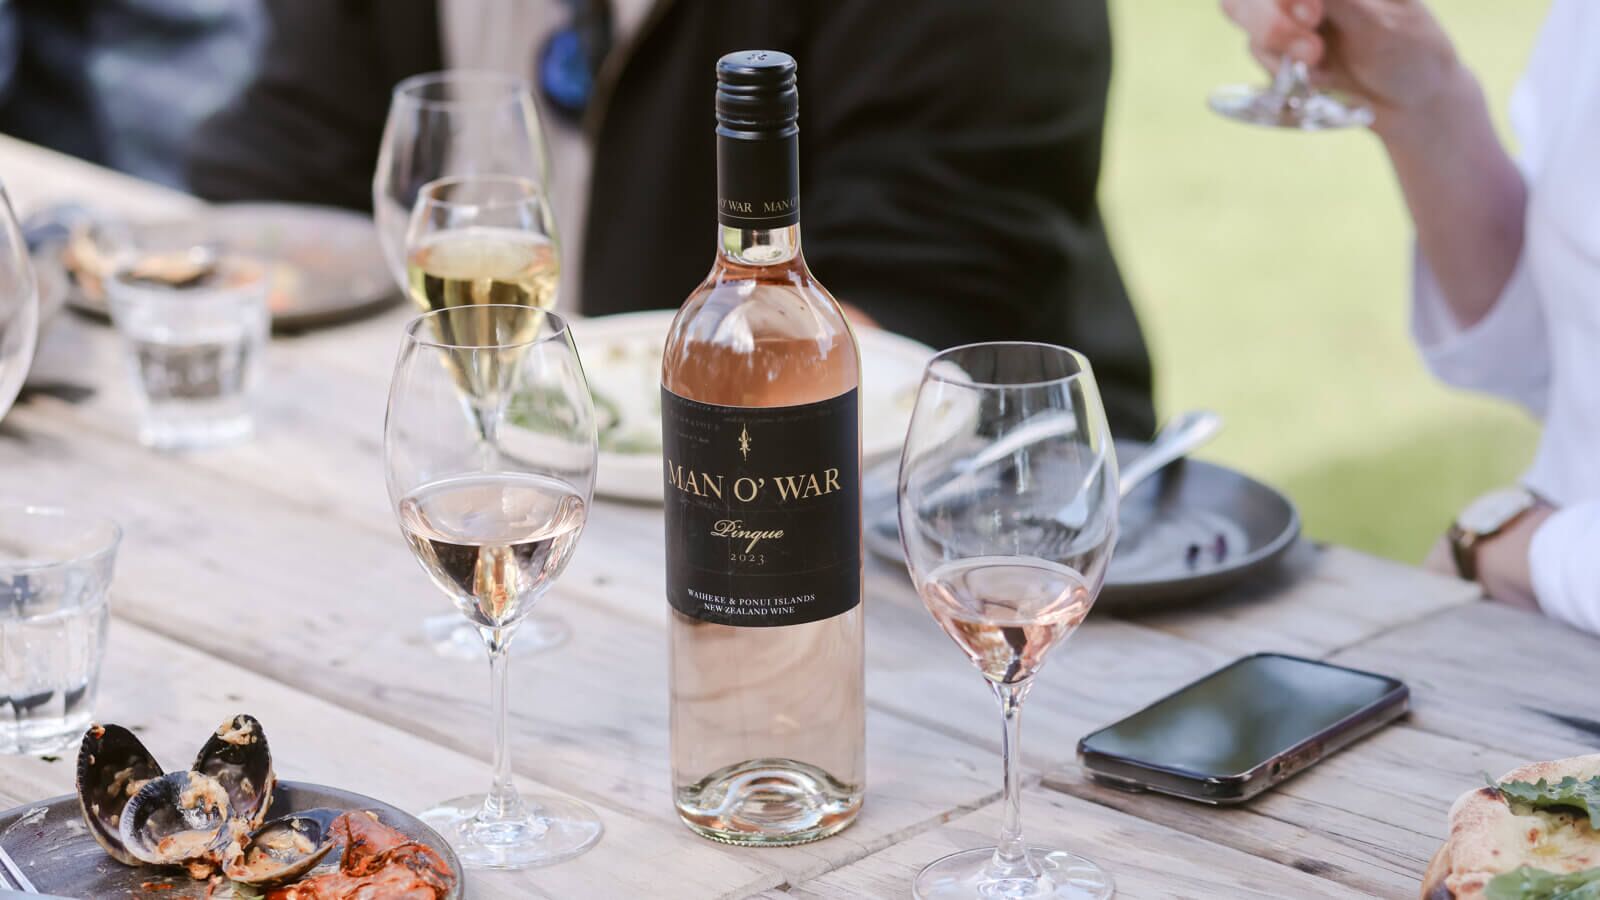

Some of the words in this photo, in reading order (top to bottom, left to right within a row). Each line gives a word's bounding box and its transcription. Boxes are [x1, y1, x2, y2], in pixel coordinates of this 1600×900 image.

[728, 200, 753, 213] WAR
[764, 199, 789, 213] MAN
[668, 459, 724, 499] MAN
[733, 477, 765, 502] O'
[773, 468, 841, 501] WAR
[710, 519, 784, 554] Pinque
[730, 554, 765, 566] 2023
[688, 588, 726, 605] WAIHEKE
[729, 597, 736, 605] &
[739, 597, 771, 606] PONUI
[774, 594, 816, 606] ISLANDS
[704, 603, 726, 613] NEW
[726, 606, 768, 616] ZEALAND
[770, 606, 795, 615] WINE
